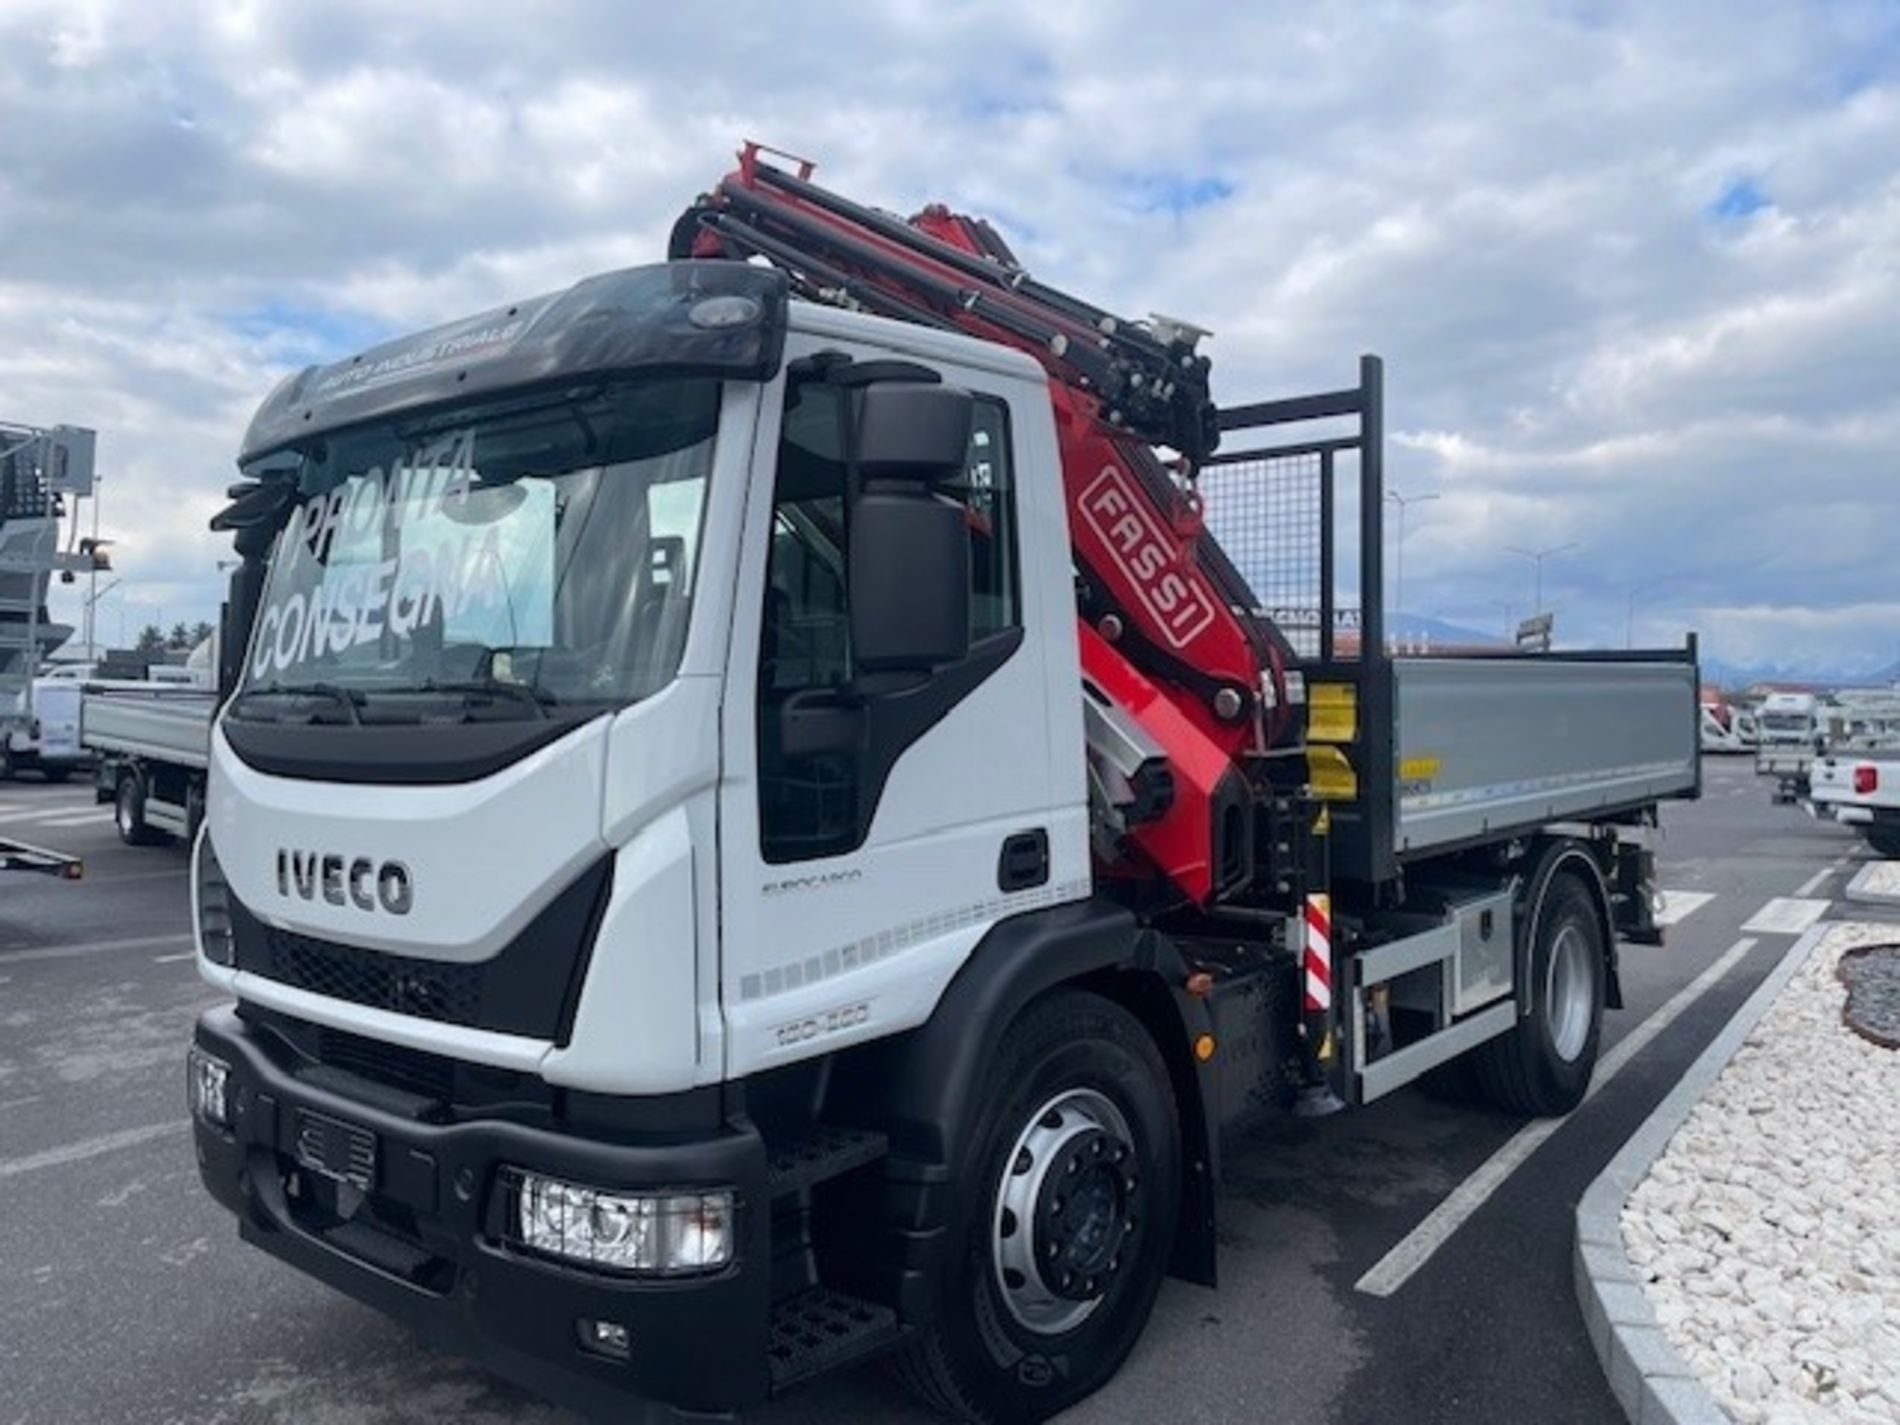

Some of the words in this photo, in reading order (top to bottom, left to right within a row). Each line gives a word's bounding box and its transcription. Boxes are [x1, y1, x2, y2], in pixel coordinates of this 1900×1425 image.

[292, 428, 475, 570] PRONTA
[1092, 488, 1198, 628] FASSI
[253, 523, 501, 680] CONSEGNA
[278, 848, 415, 915] IVECO
